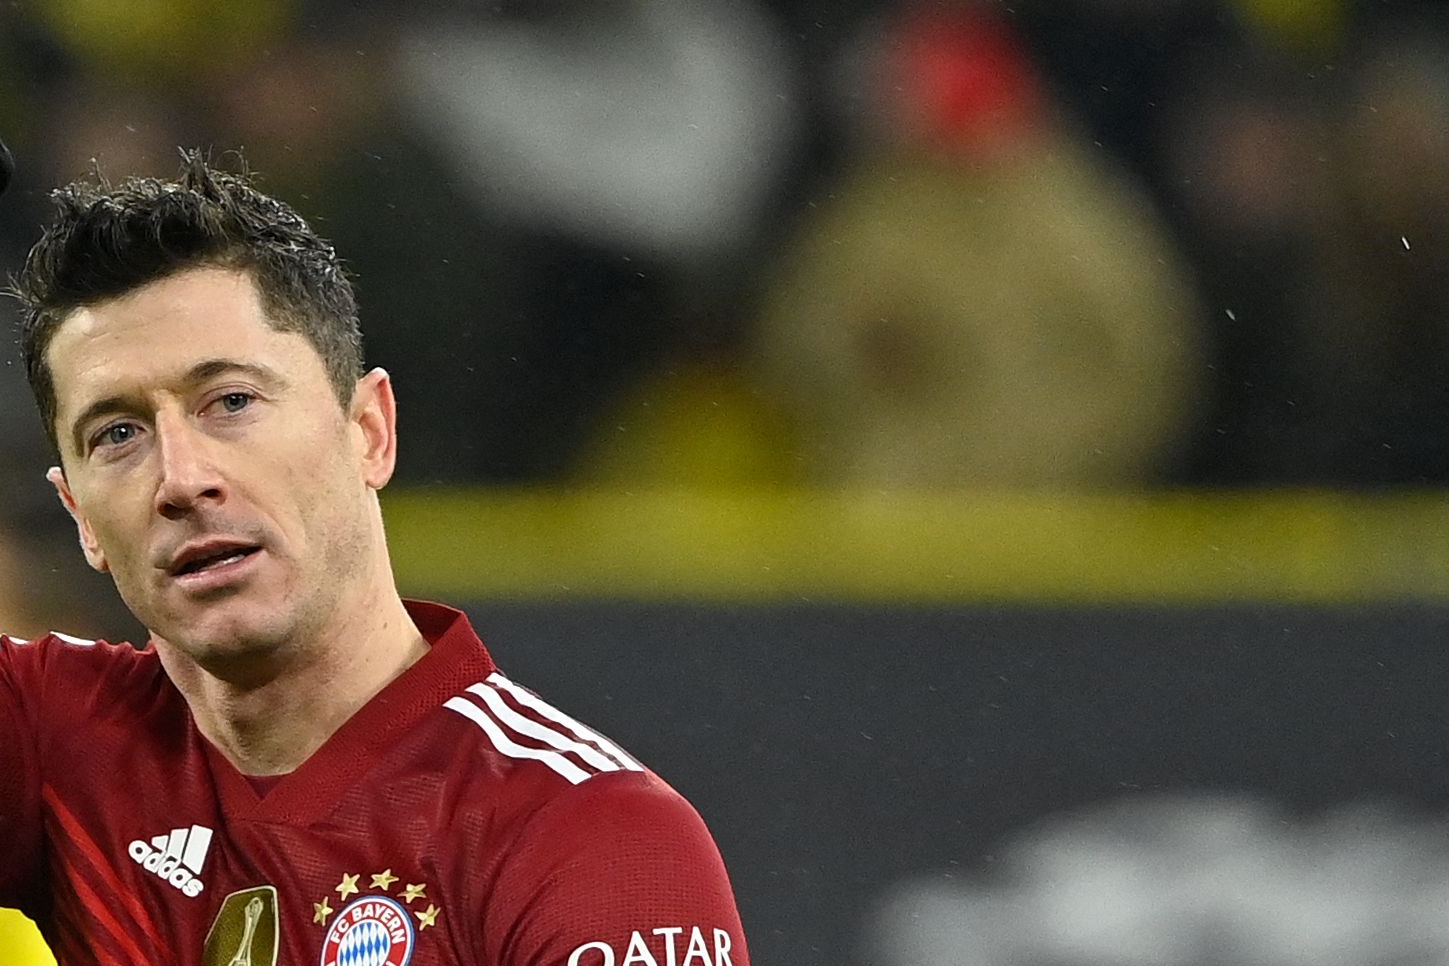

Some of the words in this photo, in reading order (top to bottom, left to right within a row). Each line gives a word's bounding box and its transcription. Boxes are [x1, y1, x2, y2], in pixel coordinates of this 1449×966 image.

[128, 840, 204, 897] addas
[330, 918, 350, 944] FC
[352, 903, 406, 944] BAYERN
